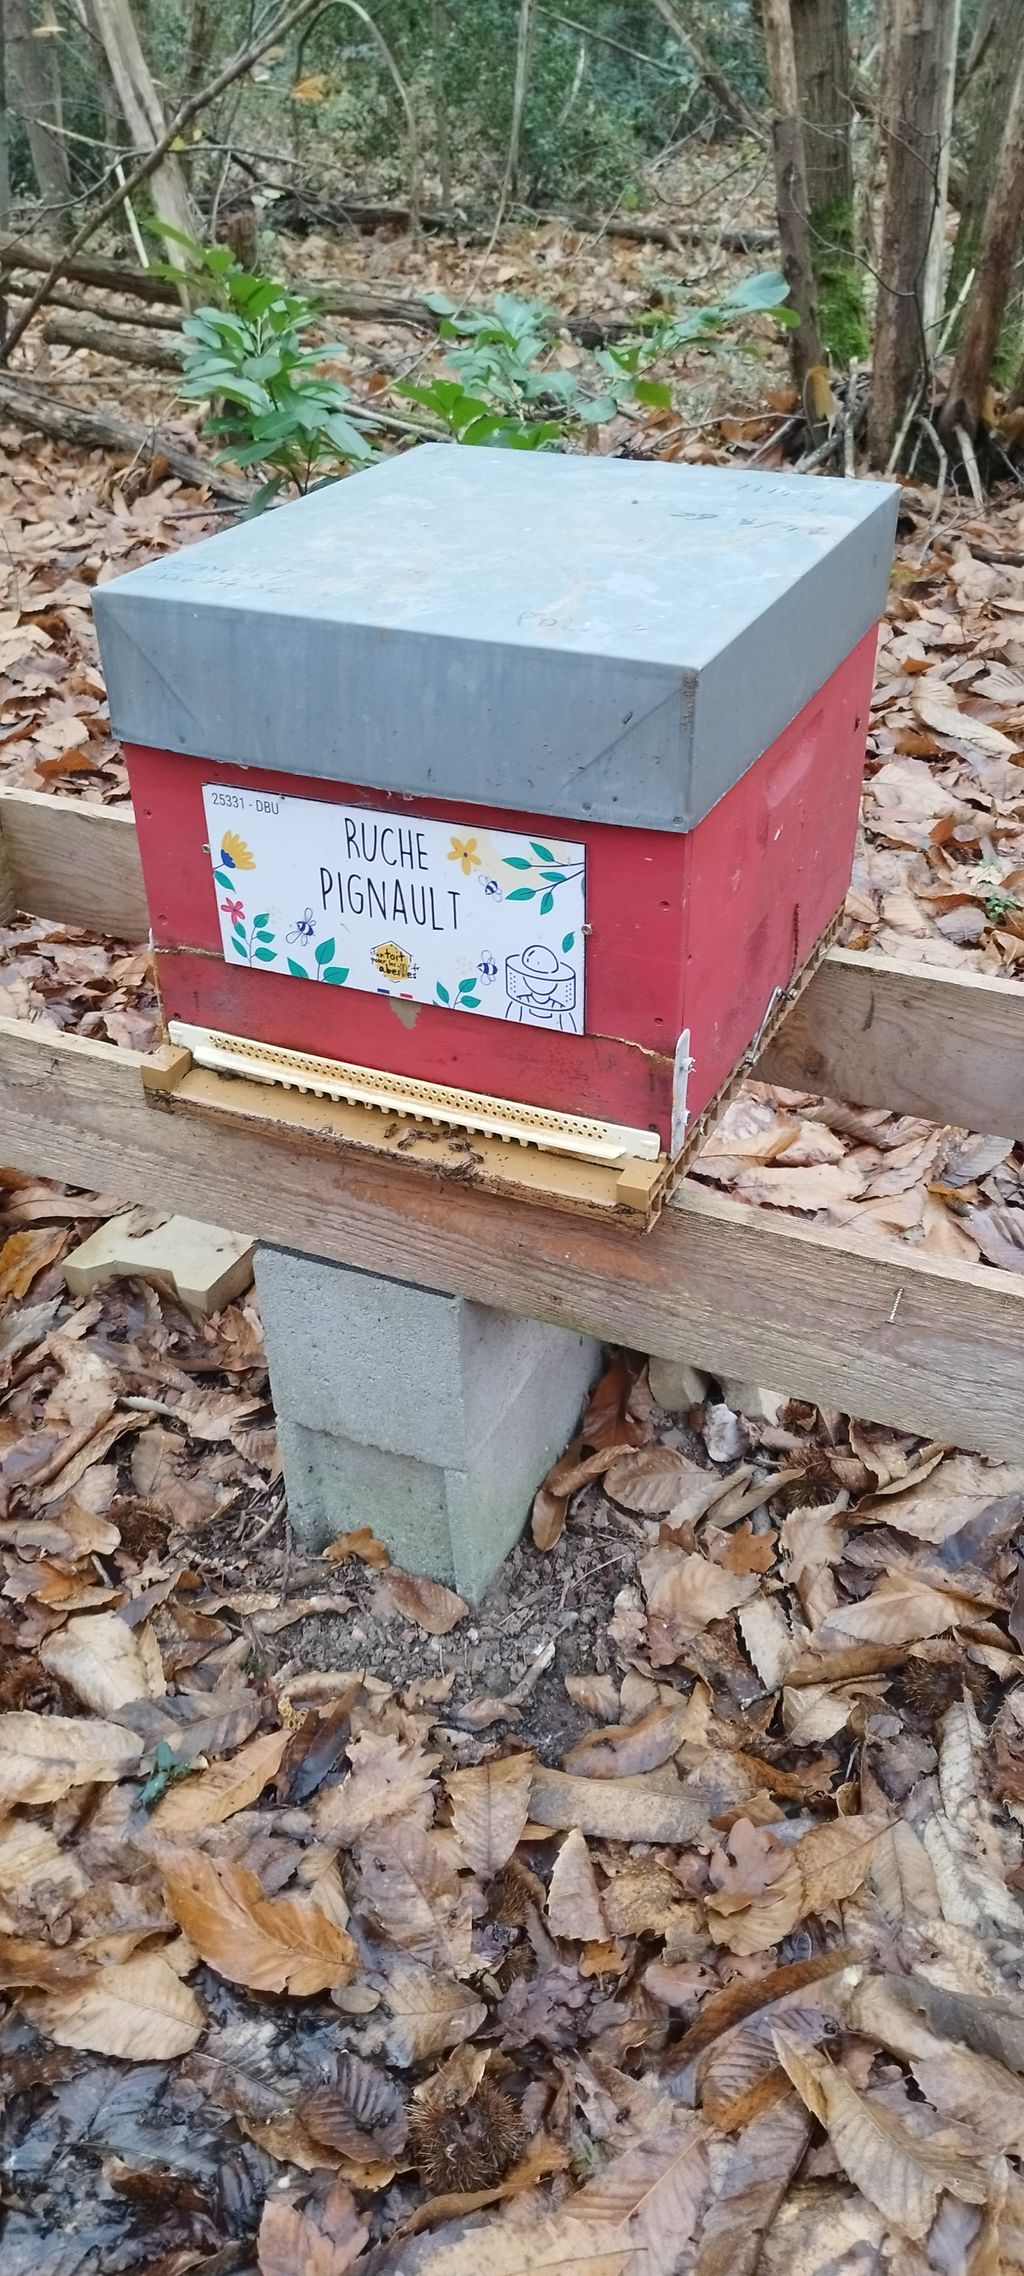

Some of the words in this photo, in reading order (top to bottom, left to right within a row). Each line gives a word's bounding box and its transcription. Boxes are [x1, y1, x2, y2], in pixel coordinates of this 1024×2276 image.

[211, 792, 245, 809] 25331
[255, 799, 279, 815] DBU
[344, 817, 429, 870] RUCHE
[320, 867, 461, 931] PIGNAULT
